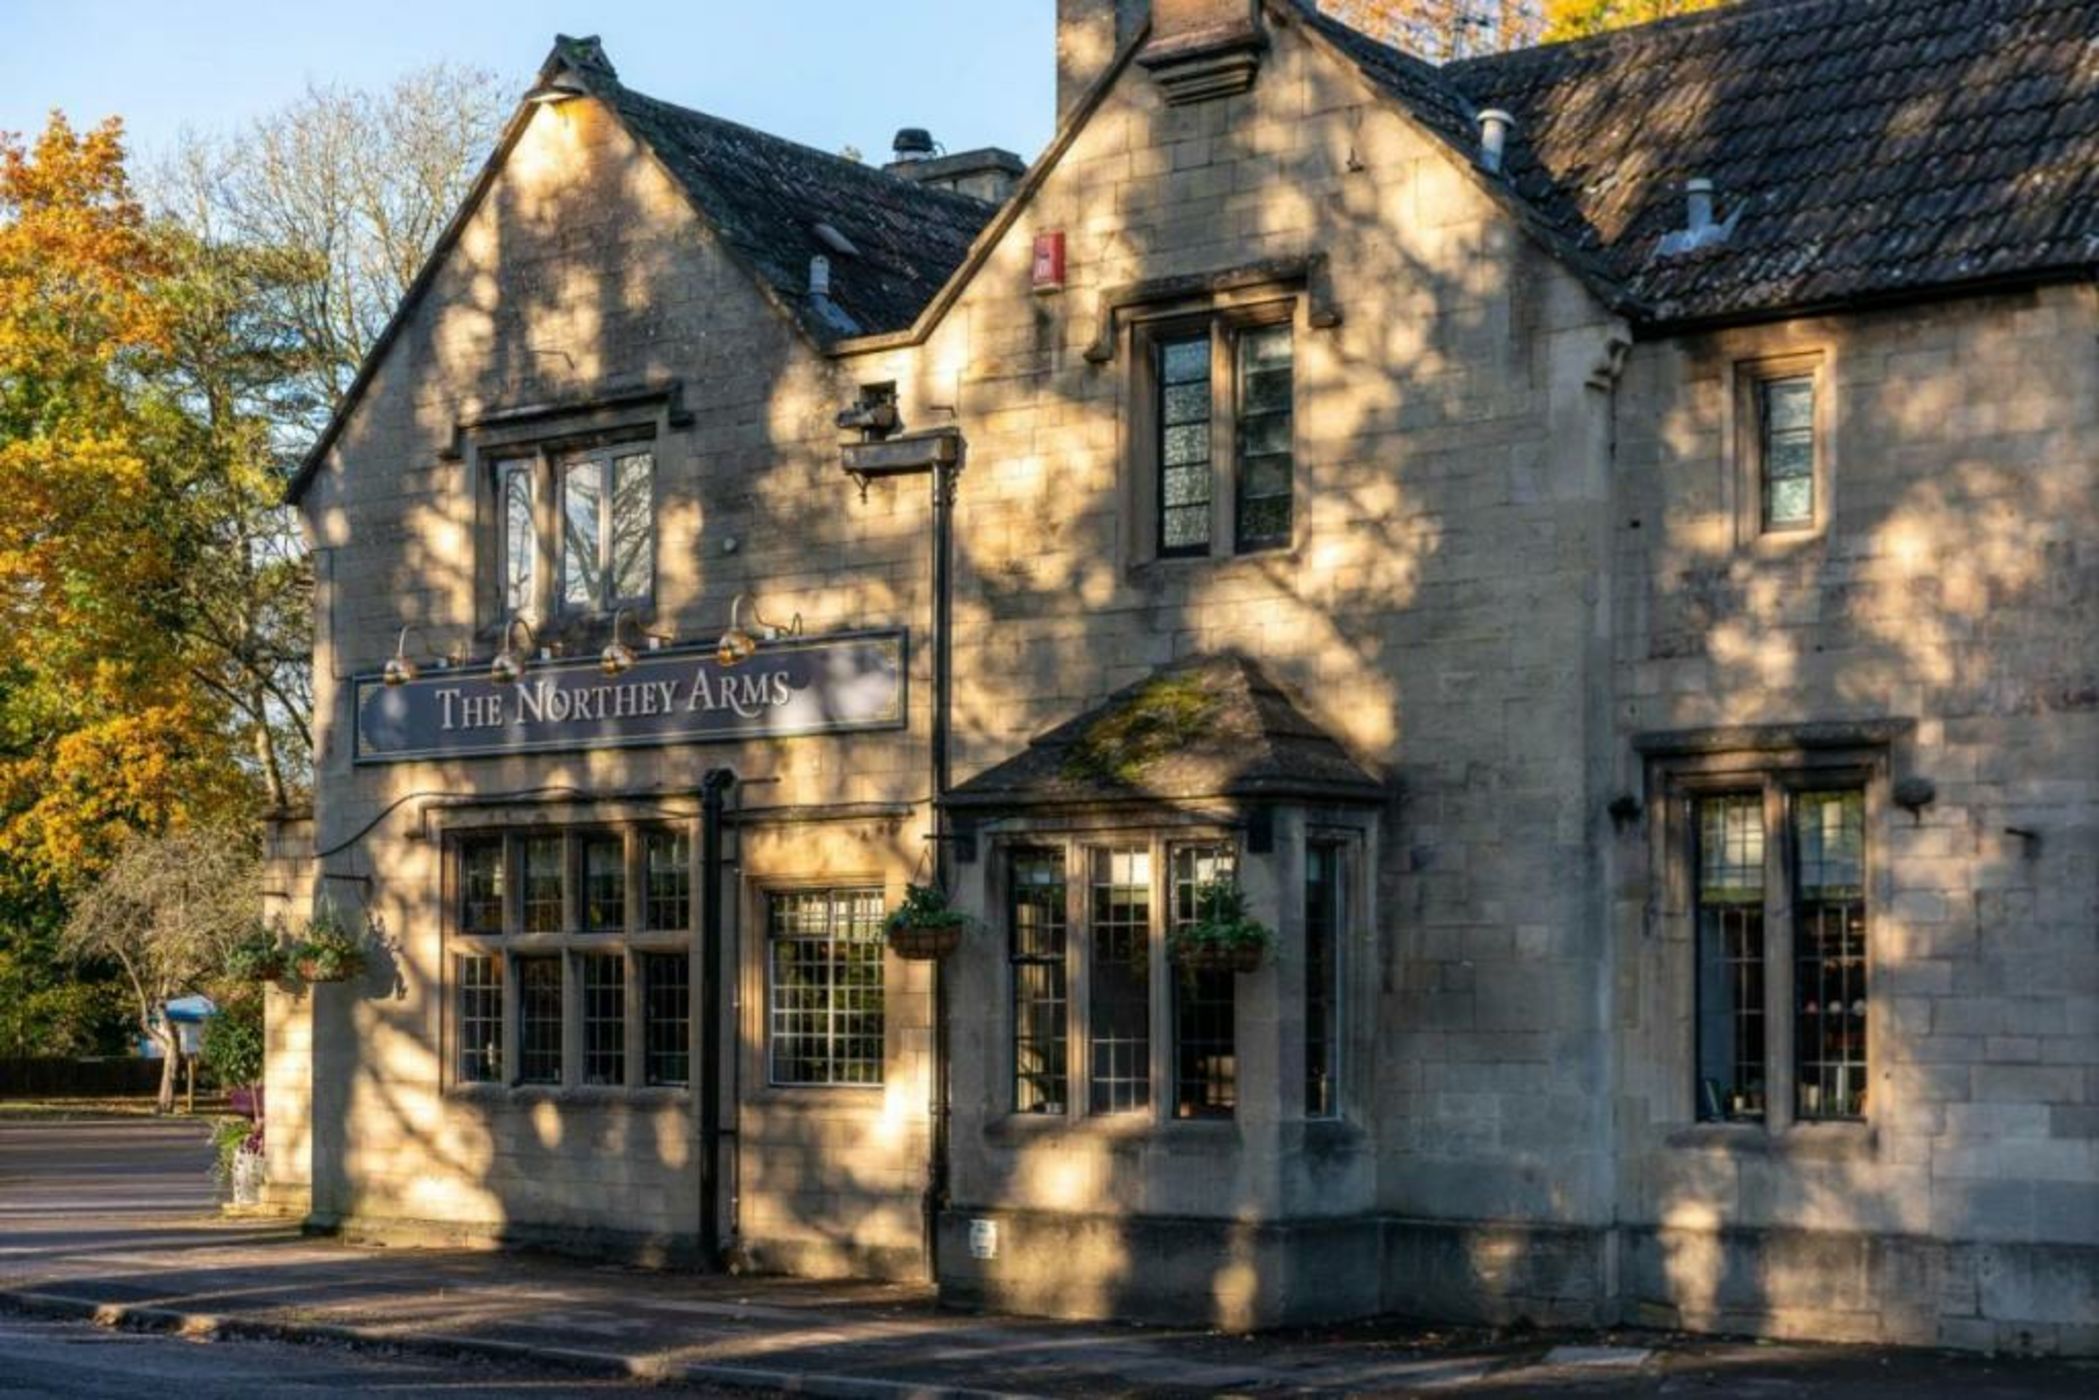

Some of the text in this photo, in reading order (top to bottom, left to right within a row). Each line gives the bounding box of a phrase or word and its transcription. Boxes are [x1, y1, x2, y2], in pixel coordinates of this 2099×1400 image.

[435, 669, 791, 730] THE NORTHEY ARMS
